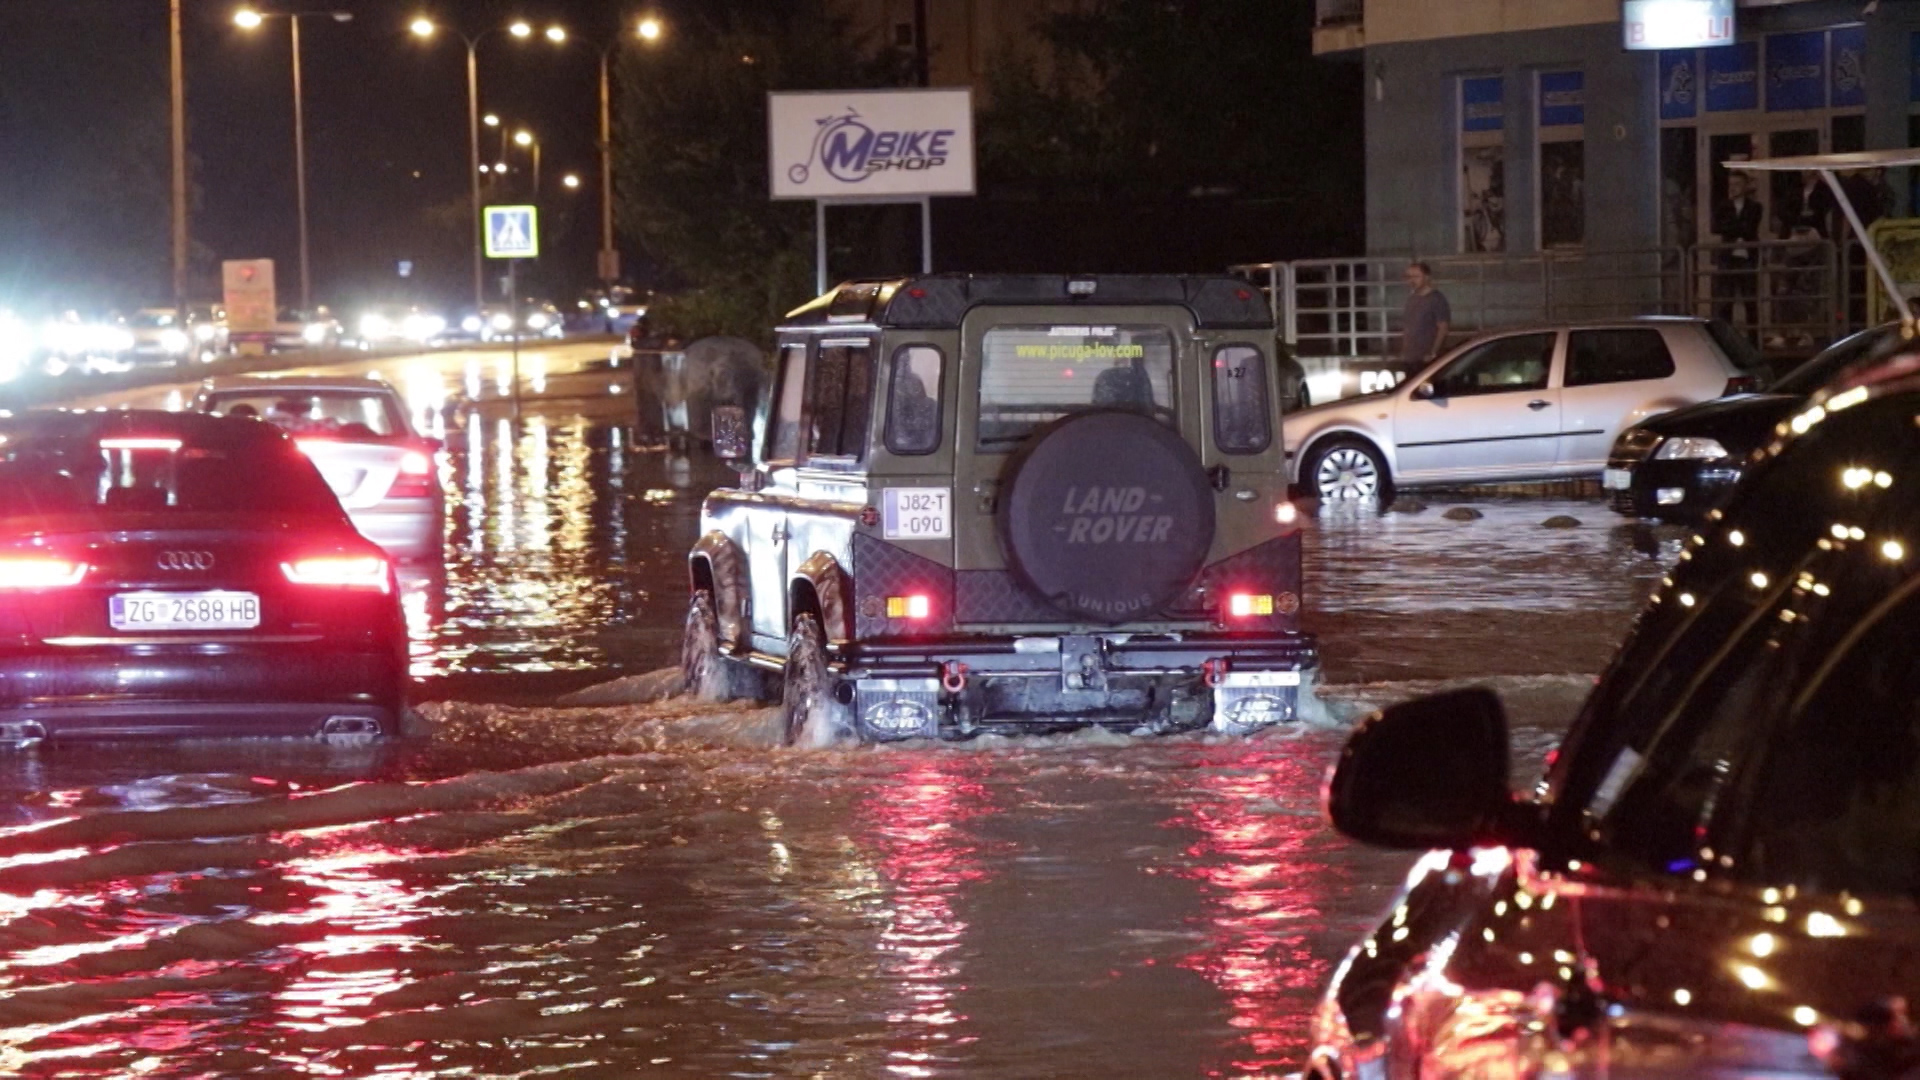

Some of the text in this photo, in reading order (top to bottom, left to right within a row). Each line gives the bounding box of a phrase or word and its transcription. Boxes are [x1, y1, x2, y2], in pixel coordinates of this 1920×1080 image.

[864, 157, 946, 171] SHOP
[1016, 341, 1143, 362] www.picuga-lov.com
[900, 493, 946, 511] J82-T
[128, 601, 155, 622] ZG
